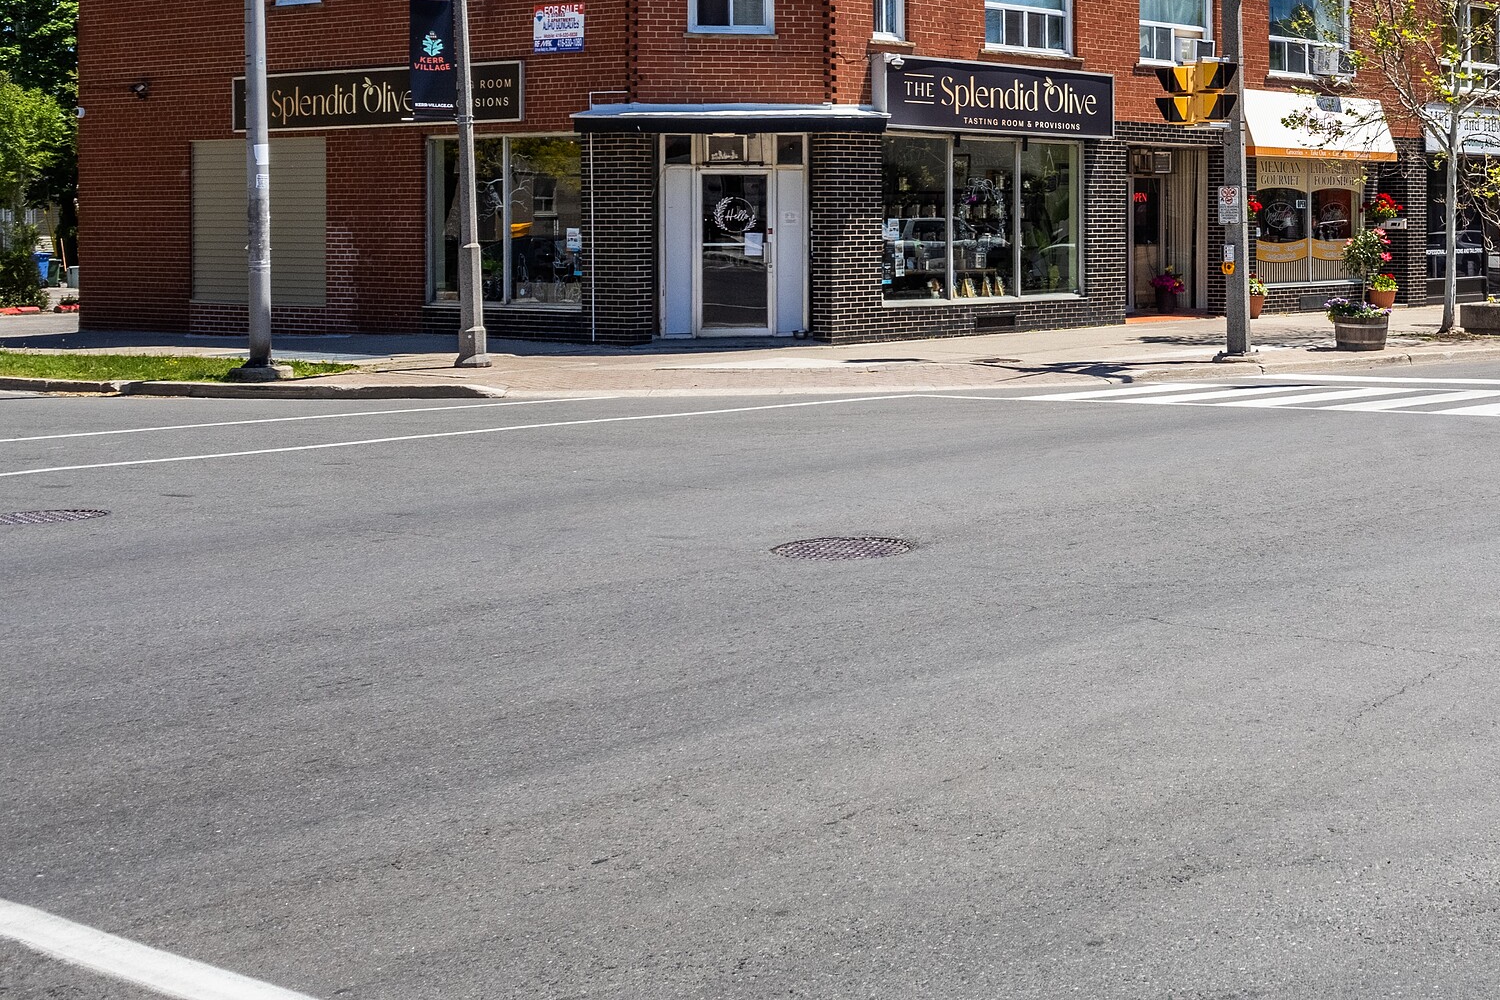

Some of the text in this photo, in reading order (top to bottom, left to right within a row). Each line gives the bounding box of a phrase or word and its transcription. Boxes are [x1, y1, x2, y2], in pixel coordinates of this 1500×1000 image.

[544, 4, 579, 15] FOR SALE
[419, 56, 444, 64] KERR
[414, 62, 451, 72] VILLAGE
[480, 78, 512, 89] ROOM
[904, 75, 1098, 116] THE Splendid Olive
[271, 84, 357, 125] Splendid
[963, 116, 1081, 131] TASTING ROOM & PROVISIONS
[1464, 120, 1480, 131] and
[1260, 161, 1301, 174] MEXICAN
[1260, 175, 1300, 186] GOURMET
[1314, 176, 1336, 186] FOOD
[724, 208, 750, 222] Hello
